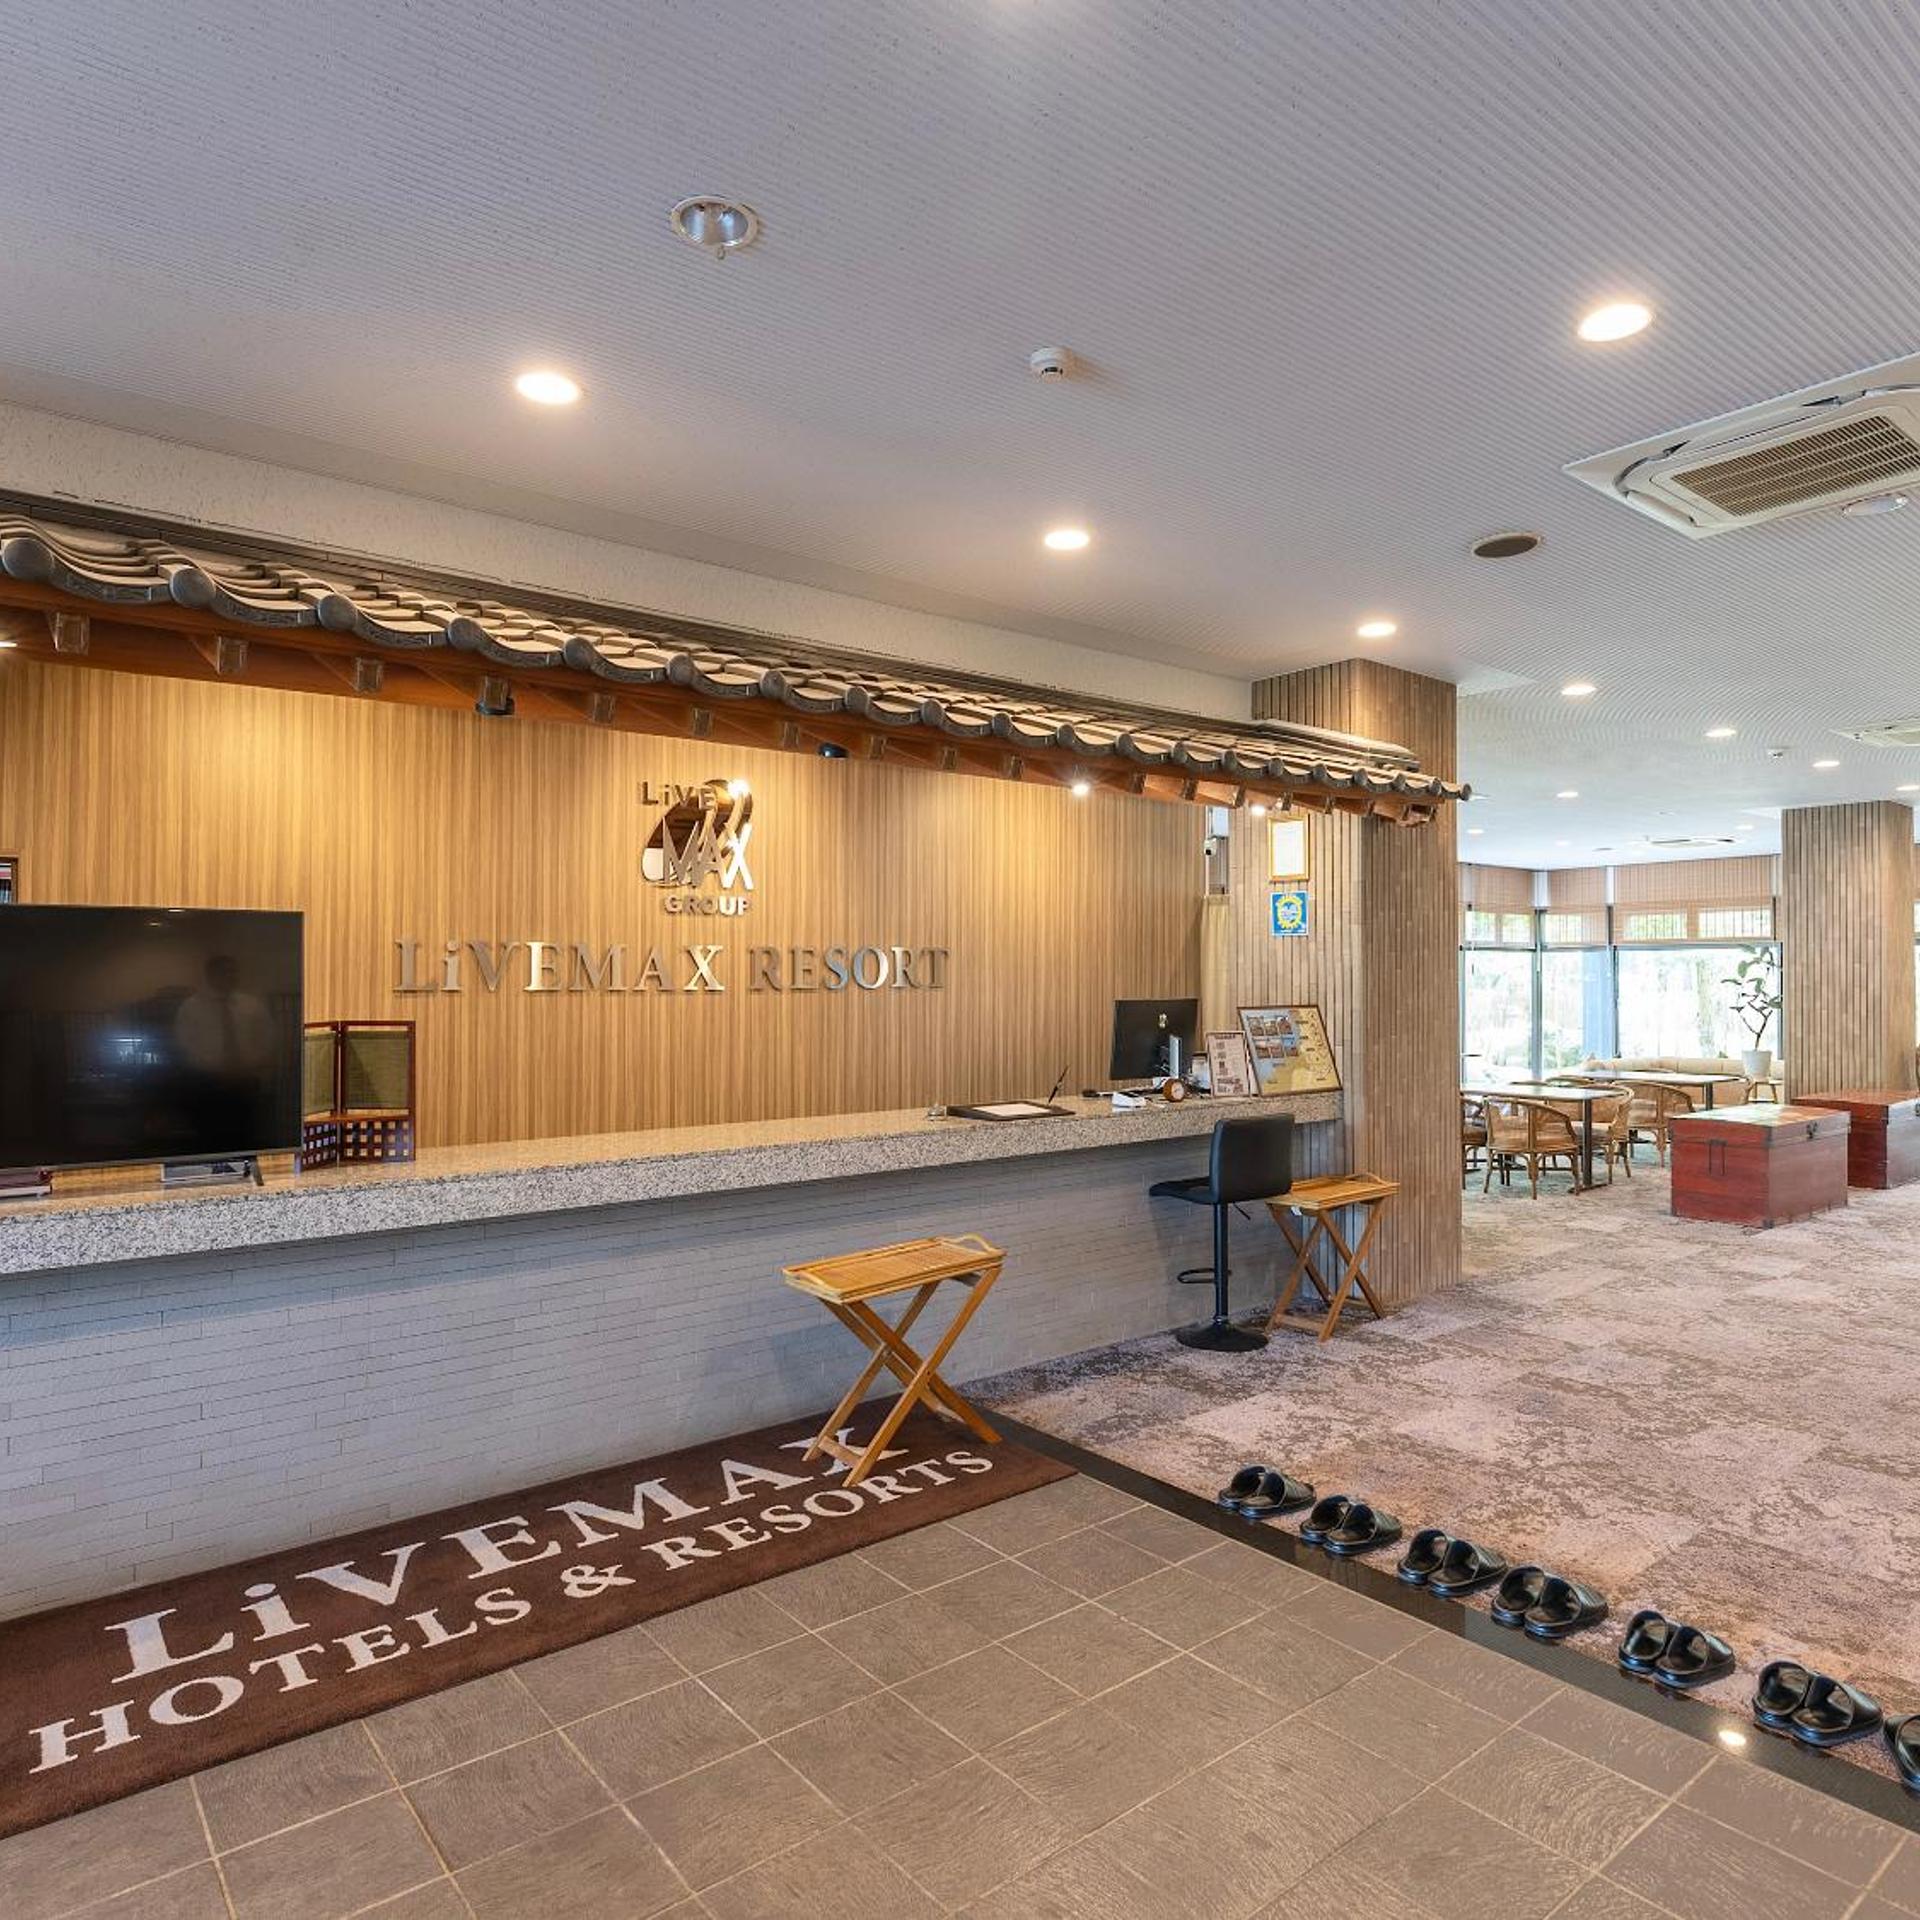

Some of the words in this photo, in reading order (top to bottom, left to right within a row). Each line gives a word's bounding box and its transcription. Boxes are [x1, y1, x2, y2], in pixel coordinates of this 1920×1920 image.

[641, 781, 716, 811] LiVE
[662, 816, 754, 890] MAX
[664, 896, 750, 915] GROUP
[393, 940, 726, 992] LiVEMAX
[748, 945, 949, 990] RESORT
[104, 1427, 909, 1684] LiVEMAX
[29, 1587, 532, 1774] HOTELS
[560, 1562, 636, 1598] &
[641, 1451, 993, 1570] RESORTS
